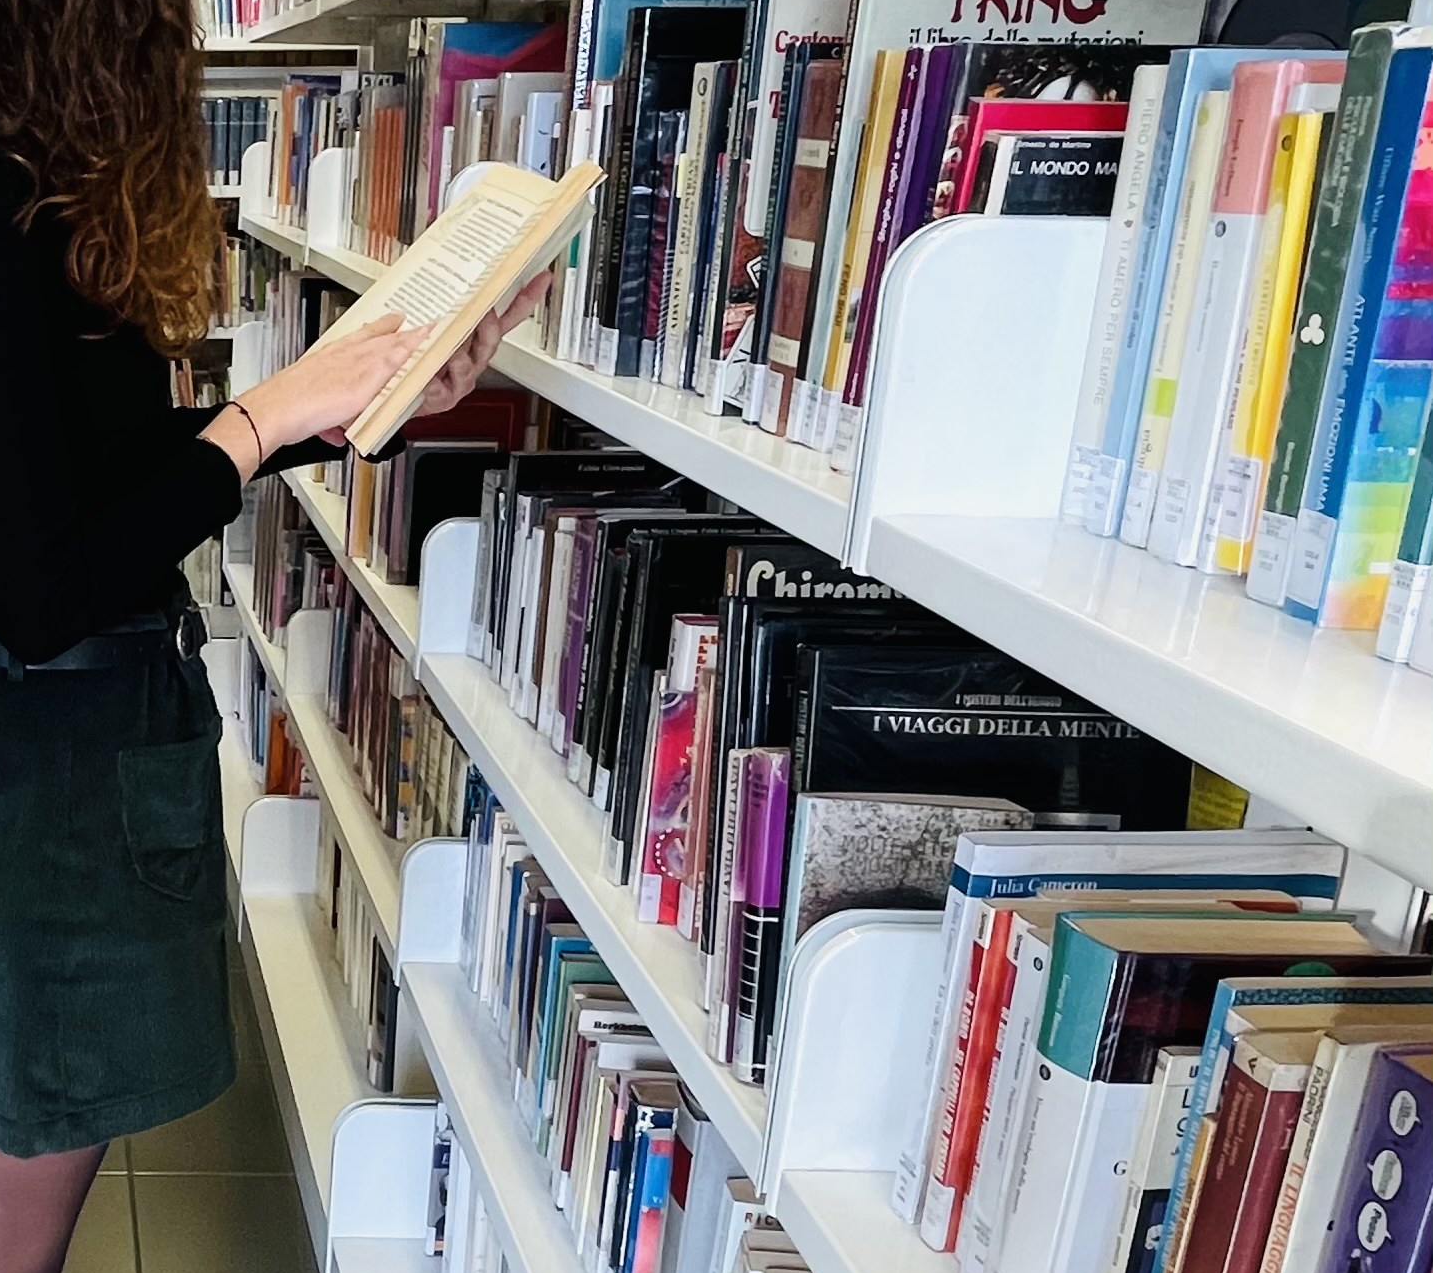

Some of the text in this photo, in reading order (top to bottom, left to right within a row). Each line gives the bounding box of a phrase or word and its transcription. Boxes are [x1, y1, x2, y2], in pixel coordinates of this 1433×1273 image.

[1011, 159, 1025, 176] IL
[1028, 159, 1090, 177] MONDO
[1125, 98, 1156, 211] PIERO ANGELA
[1104, 311, 1119, 341] PER
[1343, 294, 1366, 367] ATLANTE
[1093, 344, 1114, 407] SEMPRE
[747, 559, 907, 600] Chirom
[872, 715, 1140, 740] I VIAGGI DELLA MENTE
[989, 877, 1098, 896] Julia Cameron
[1113, 1160, 1127, 1177] G
